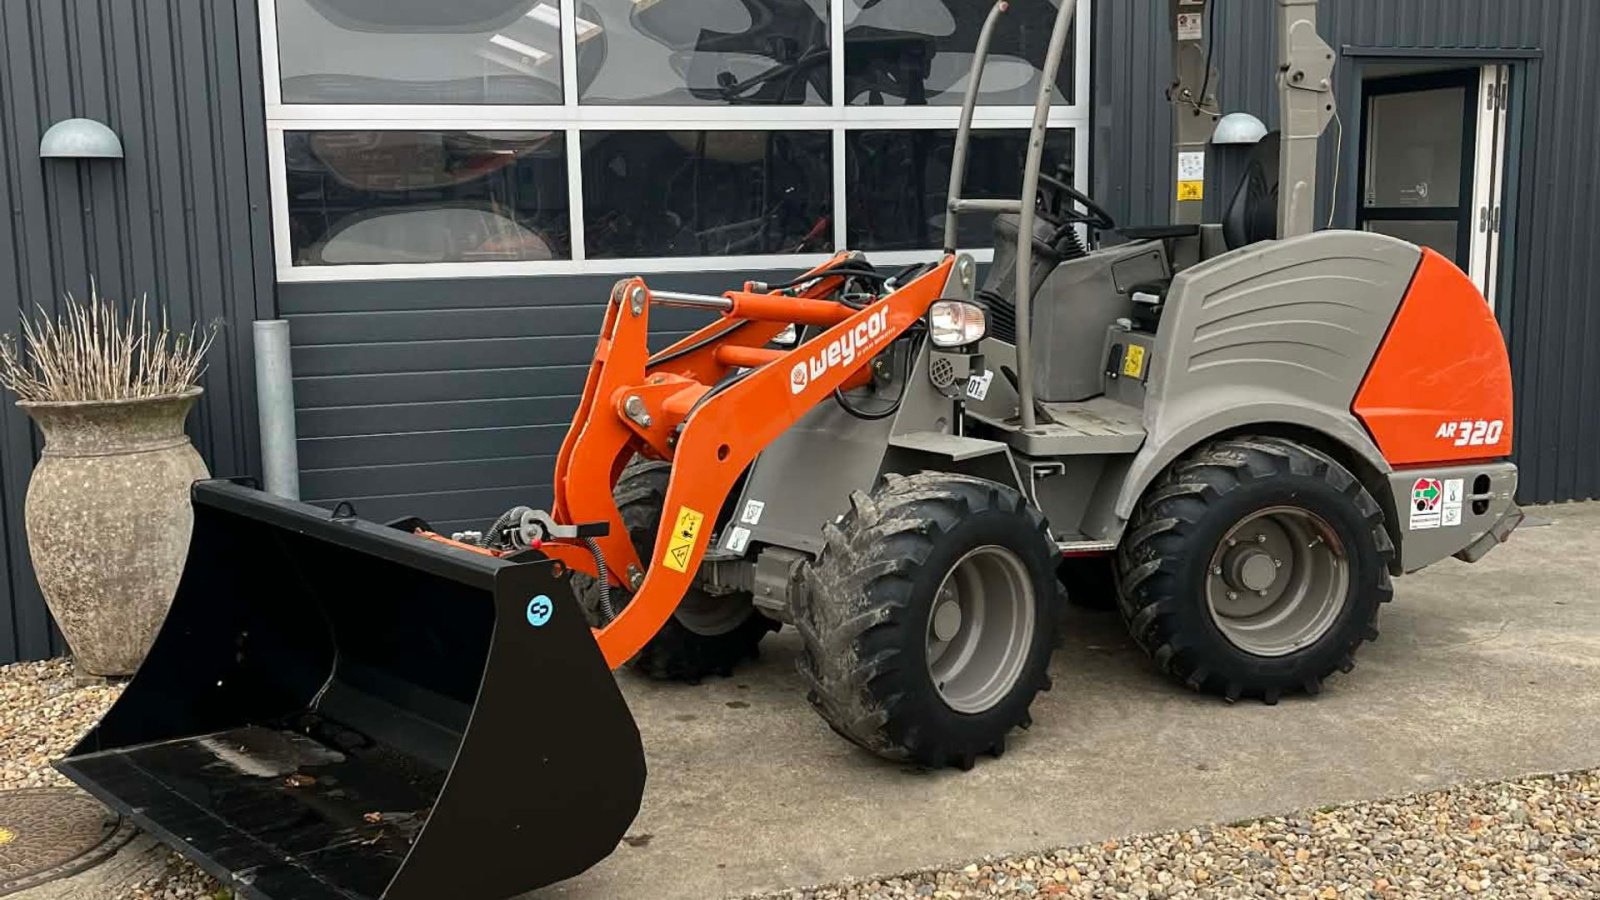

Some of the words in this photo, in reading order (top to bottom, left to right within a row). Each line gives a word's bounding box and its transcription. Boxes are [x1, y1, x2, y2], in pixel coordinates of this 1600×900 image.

[809, 304, 889, 381] weycor
[1435, 421, 1457, 438] AR
[1454, 420, 1504, 446] 320
